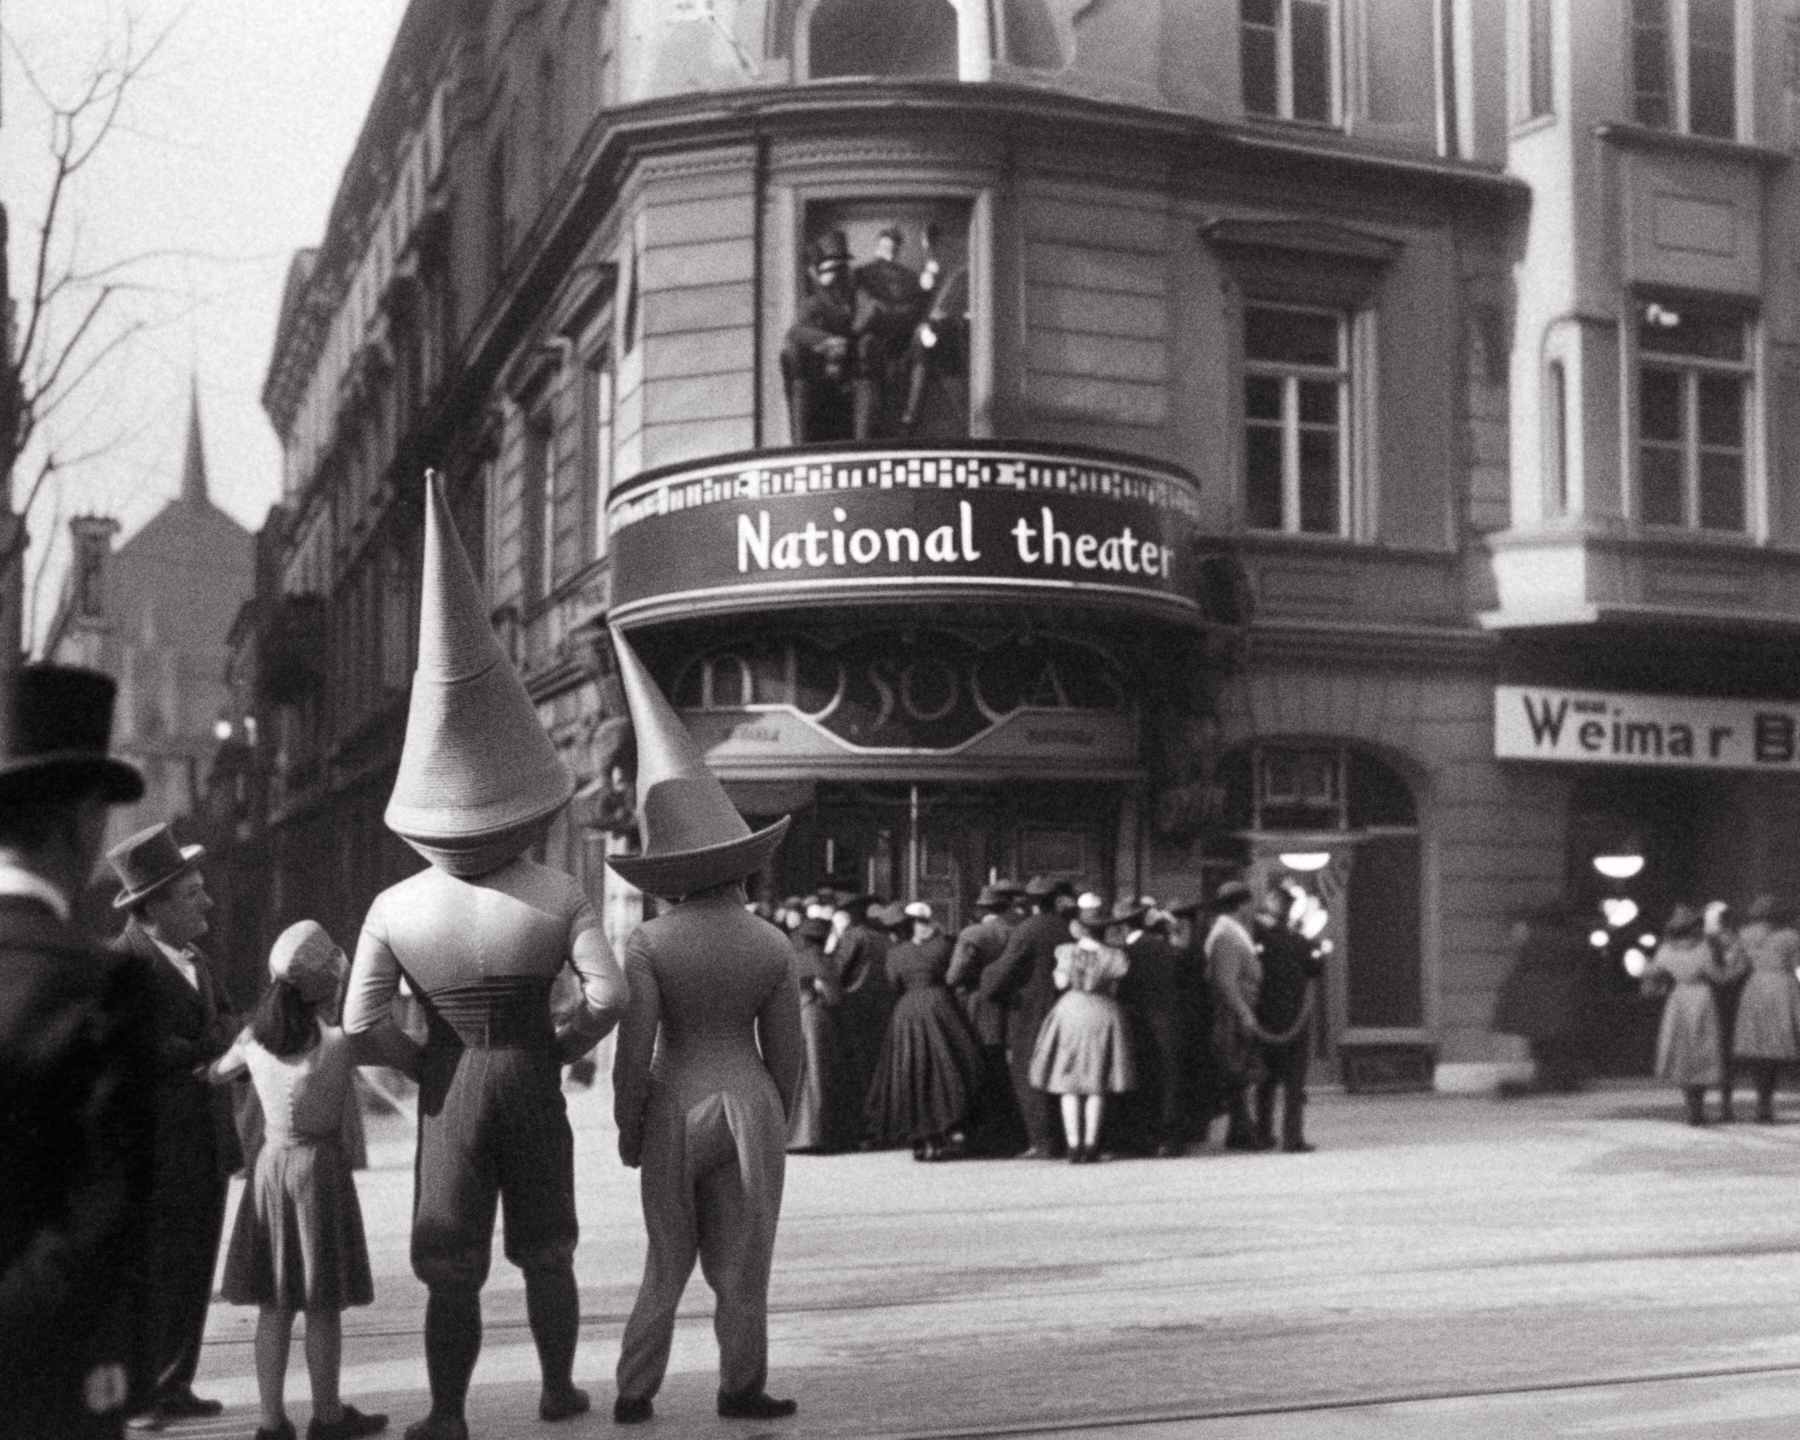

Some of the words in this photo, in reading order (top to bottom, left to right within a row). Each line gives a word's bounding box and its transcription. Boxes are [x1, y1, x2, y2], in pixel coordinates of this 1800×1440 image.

[737, 500, 981, 572] National
[1011, 506, 1175, 579] theater
[1523, 696, 1732, 758] Weimar
